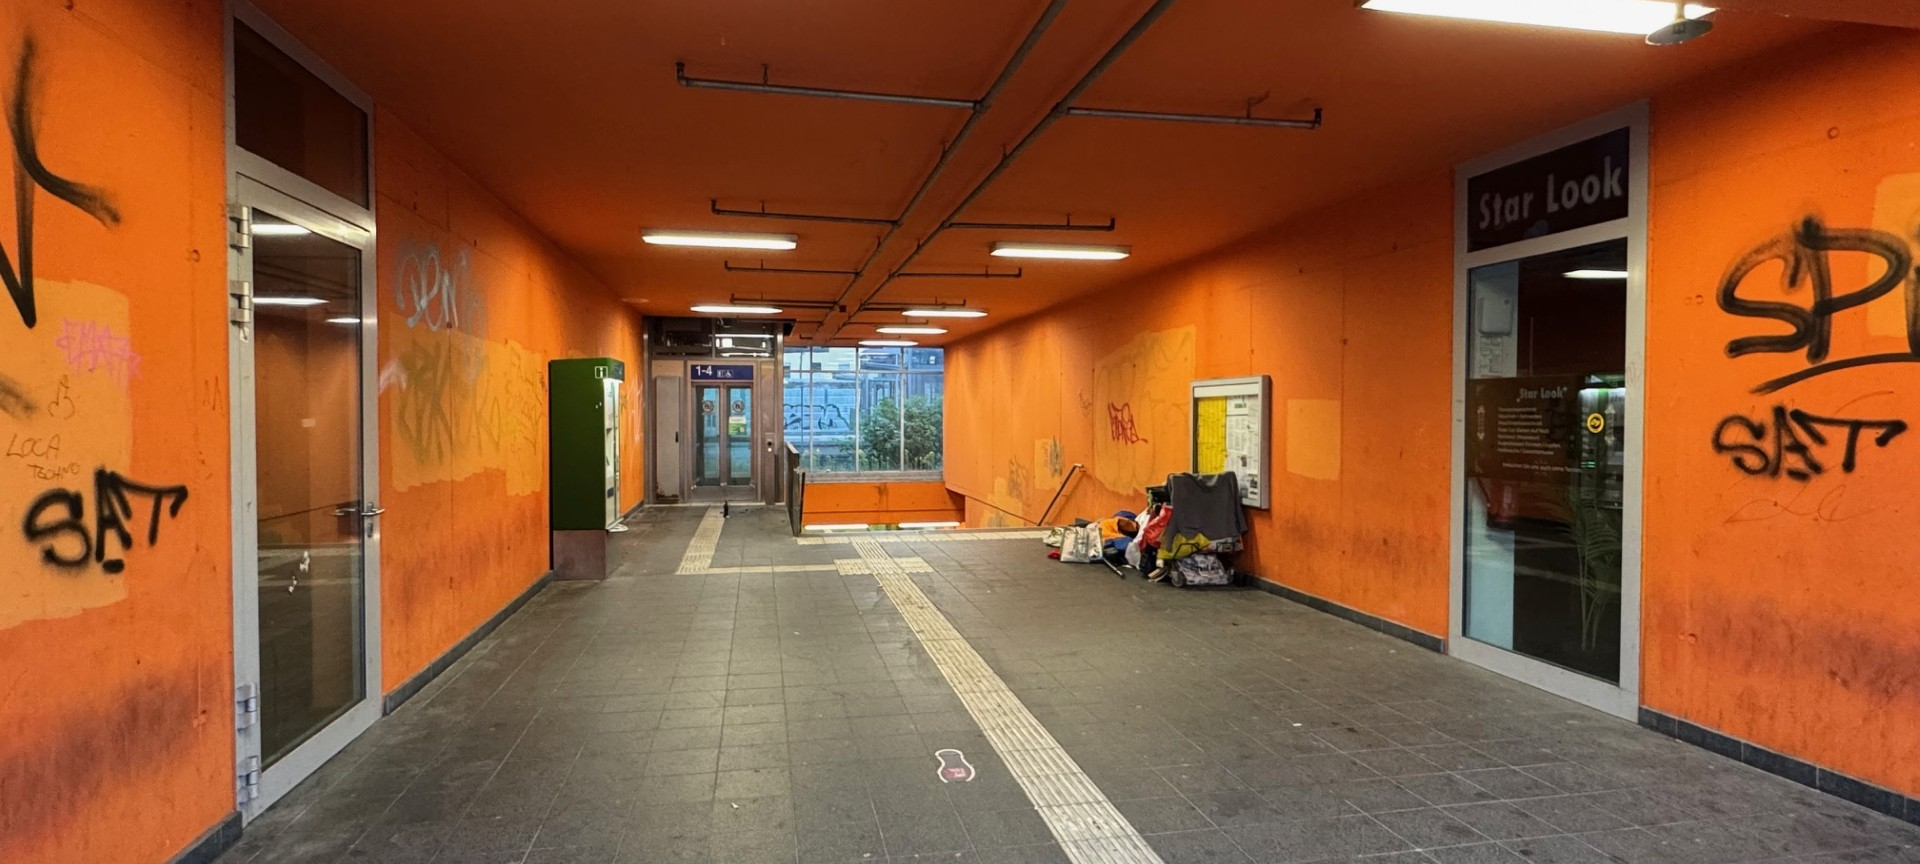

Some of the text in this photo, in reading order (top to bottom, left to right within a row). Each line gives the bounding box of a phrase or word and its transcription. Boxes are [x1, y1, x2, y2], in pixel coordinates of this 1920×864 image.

[1479, 155, 1623, 231] Star Look
[695, 365, 713, 377] 1-4
[1519, 386, 1563, 399] Star Look
